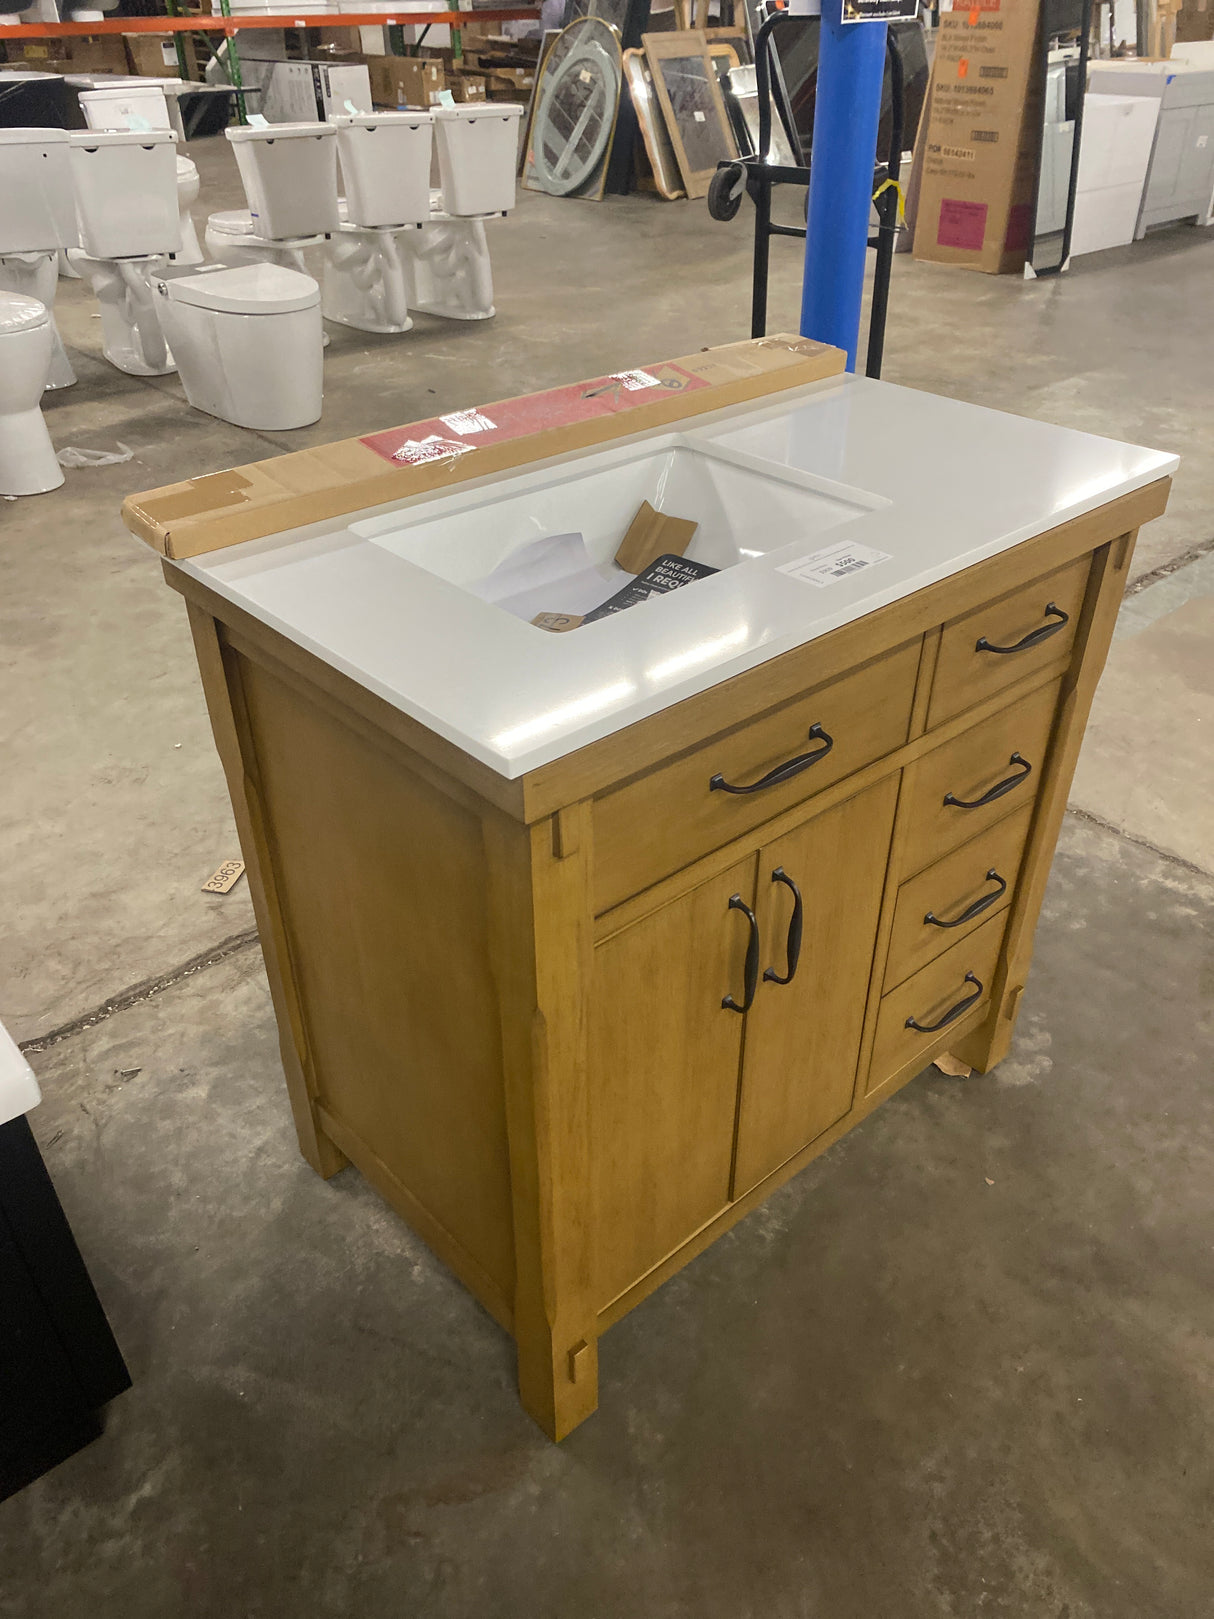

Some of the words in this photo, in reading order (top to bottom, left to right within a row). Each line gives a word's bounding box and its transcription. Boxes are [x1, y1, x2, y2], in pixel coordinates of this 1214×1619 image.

[646, 572, 655, 580] I
[662, 559, 683, 571] LIKE
[681, 566, 698, 576] ALL
[207, 862, 242, 889] 3963
